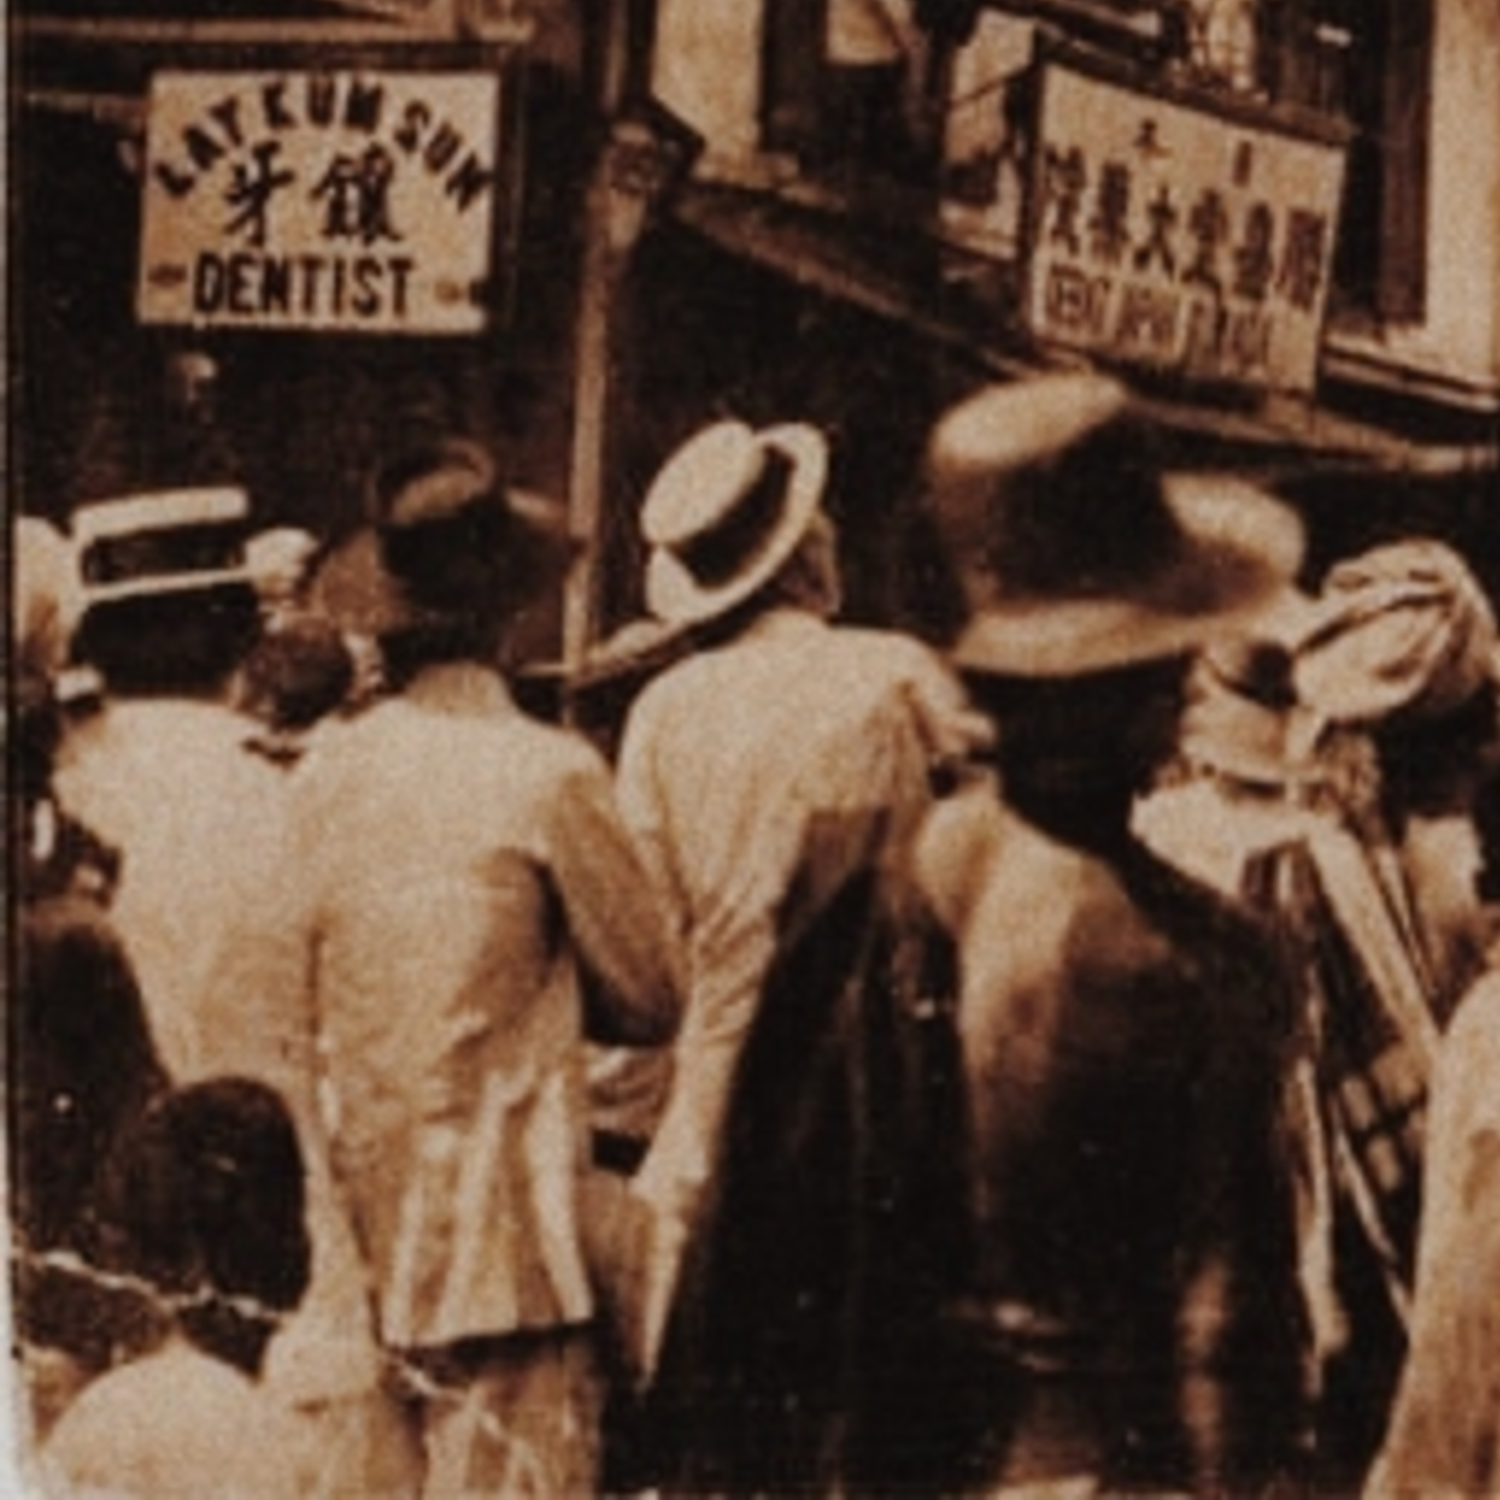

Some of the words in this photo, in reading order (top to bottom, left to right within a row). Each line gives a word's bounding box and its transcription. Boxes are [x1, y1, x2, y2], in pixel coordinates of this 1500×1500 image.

[155, 97, 243, 196] LAY
[263, 77, 383, 133] KUM
[394, 101, 494, 213] SUN
[195, 253, 413, 317] DENTIST
